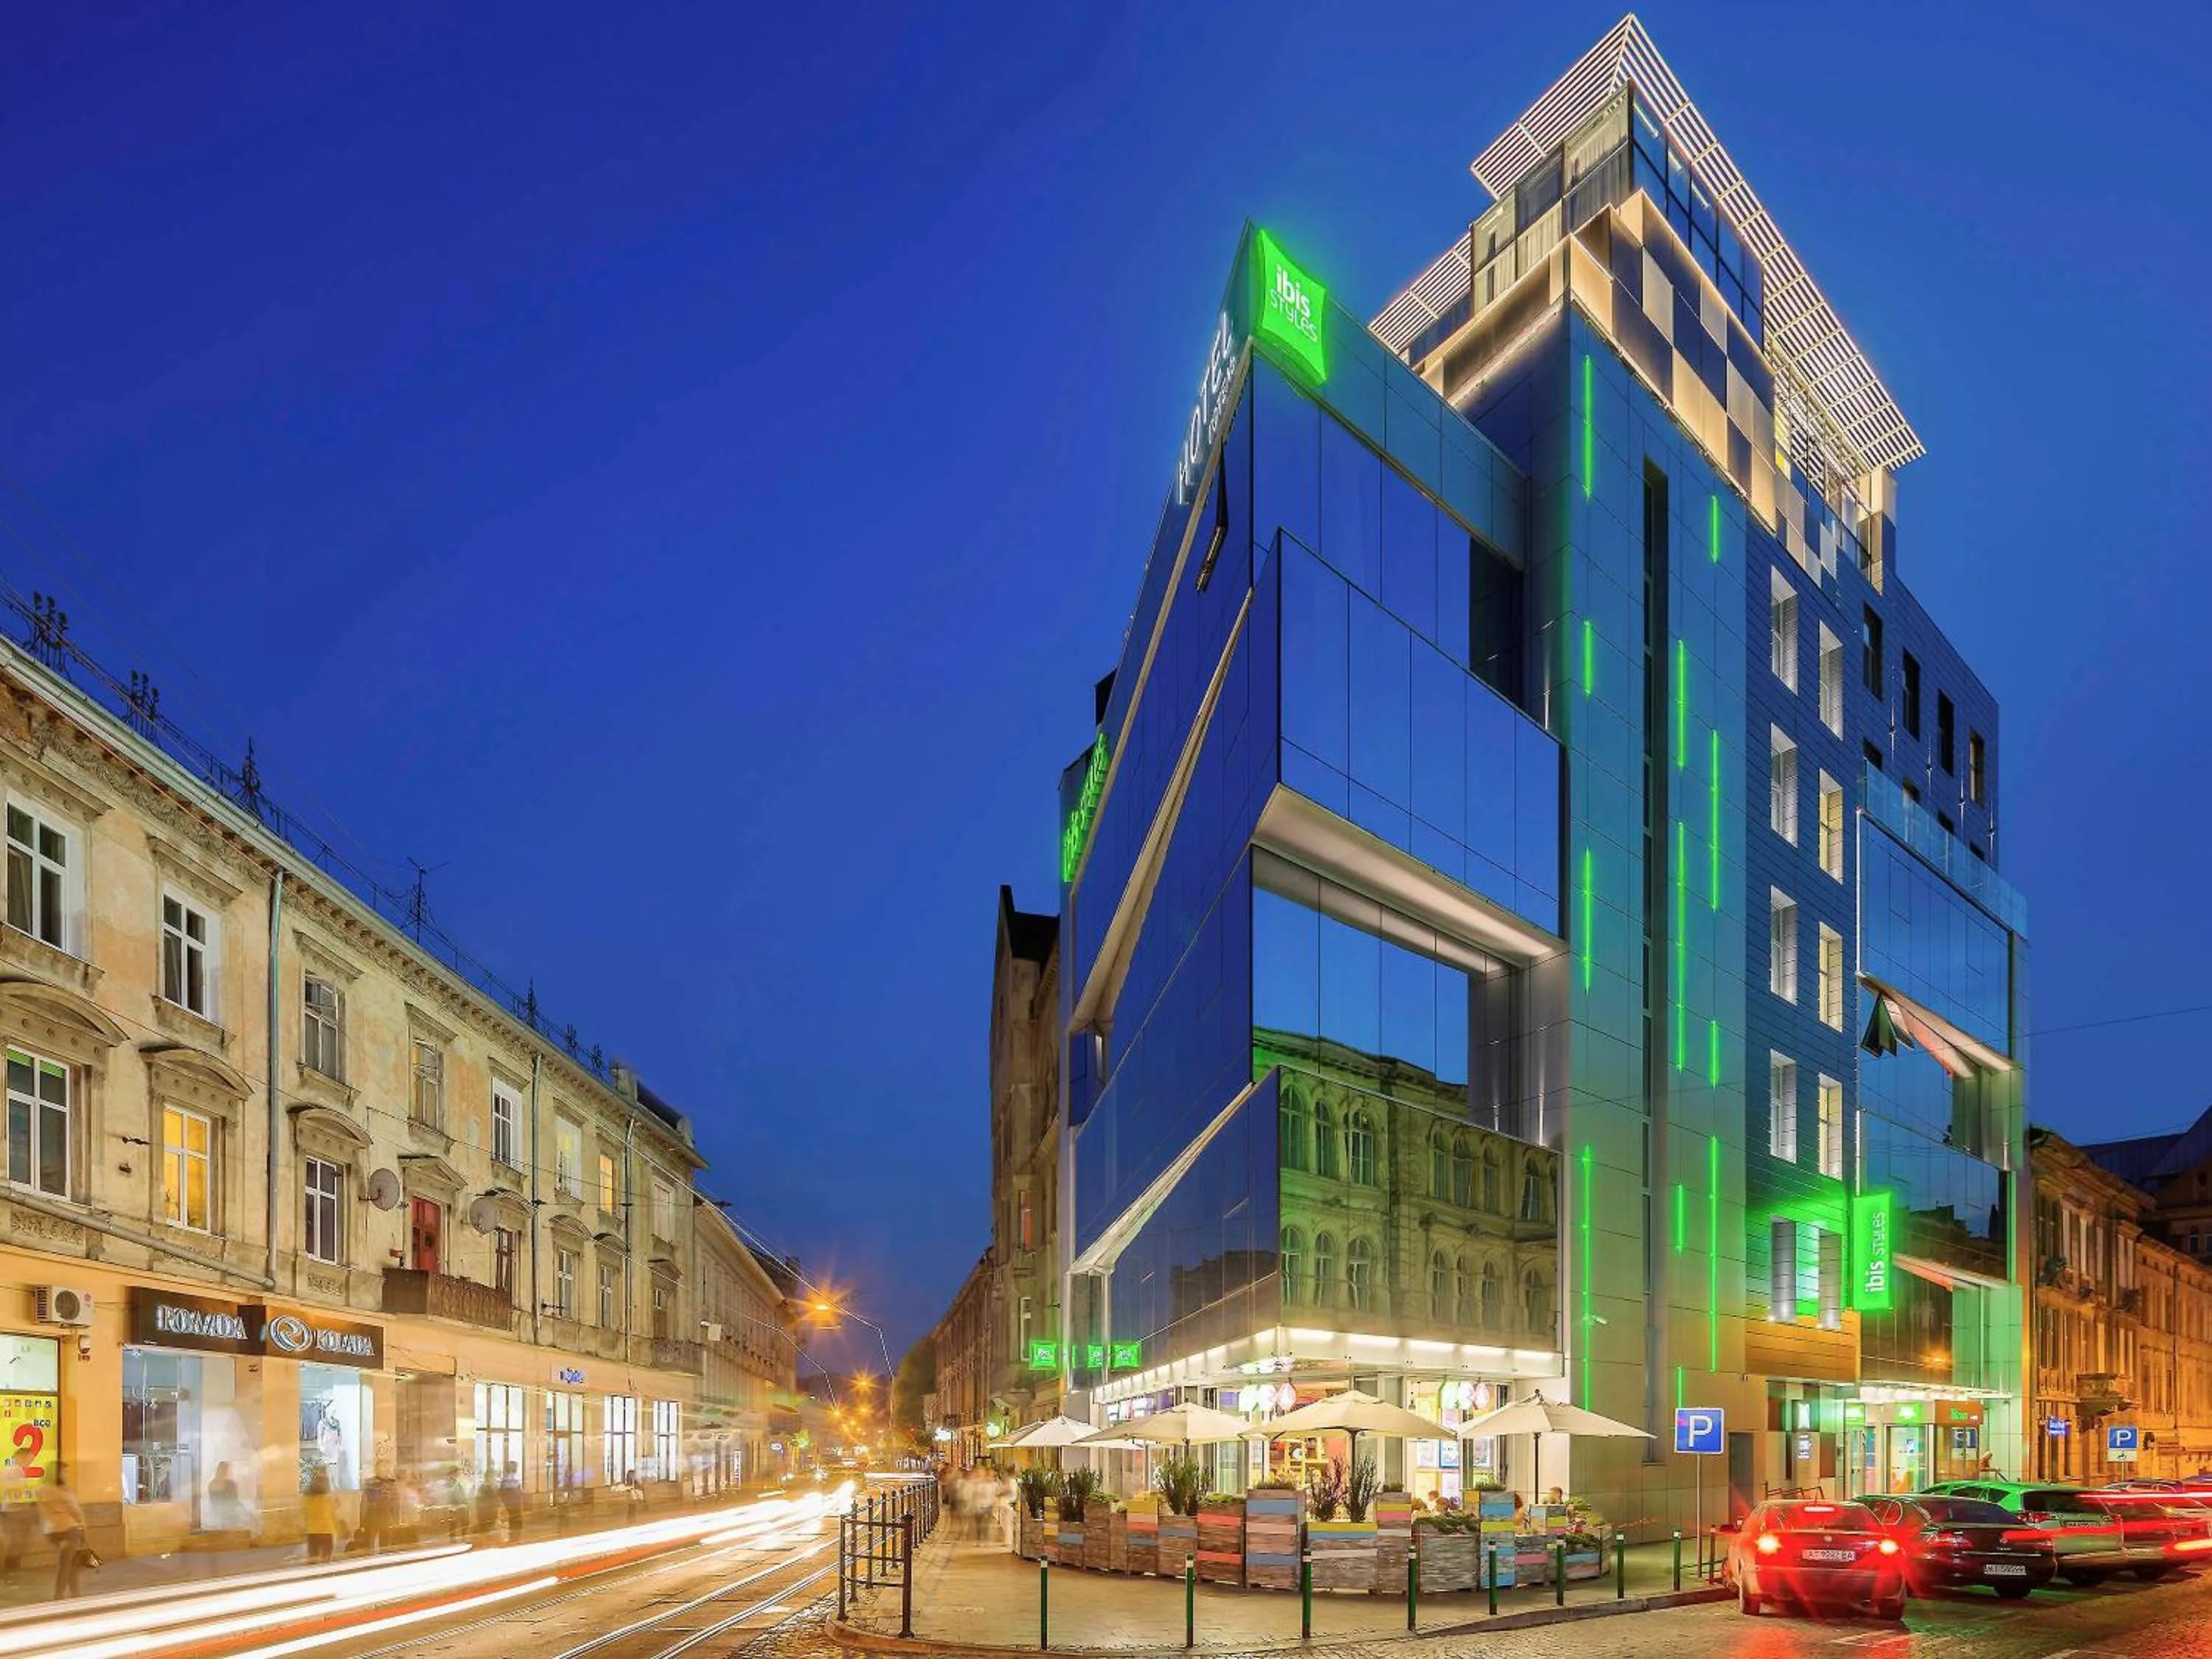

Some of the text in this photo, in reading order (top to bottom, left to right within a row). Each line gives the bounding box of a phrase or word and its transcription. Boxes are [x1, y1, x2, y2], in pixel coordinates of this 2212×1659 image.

[1276, 264, 1310, 319] ibis
[1178, 311, 1233, 506] HOTEL
[1865, 1259, 1885, 1293] ibis
[13, 1423, 44, 1478] 2
[1688, 1415, 1714, 1447] P
[2115, 1430, 2132, 1447] P
